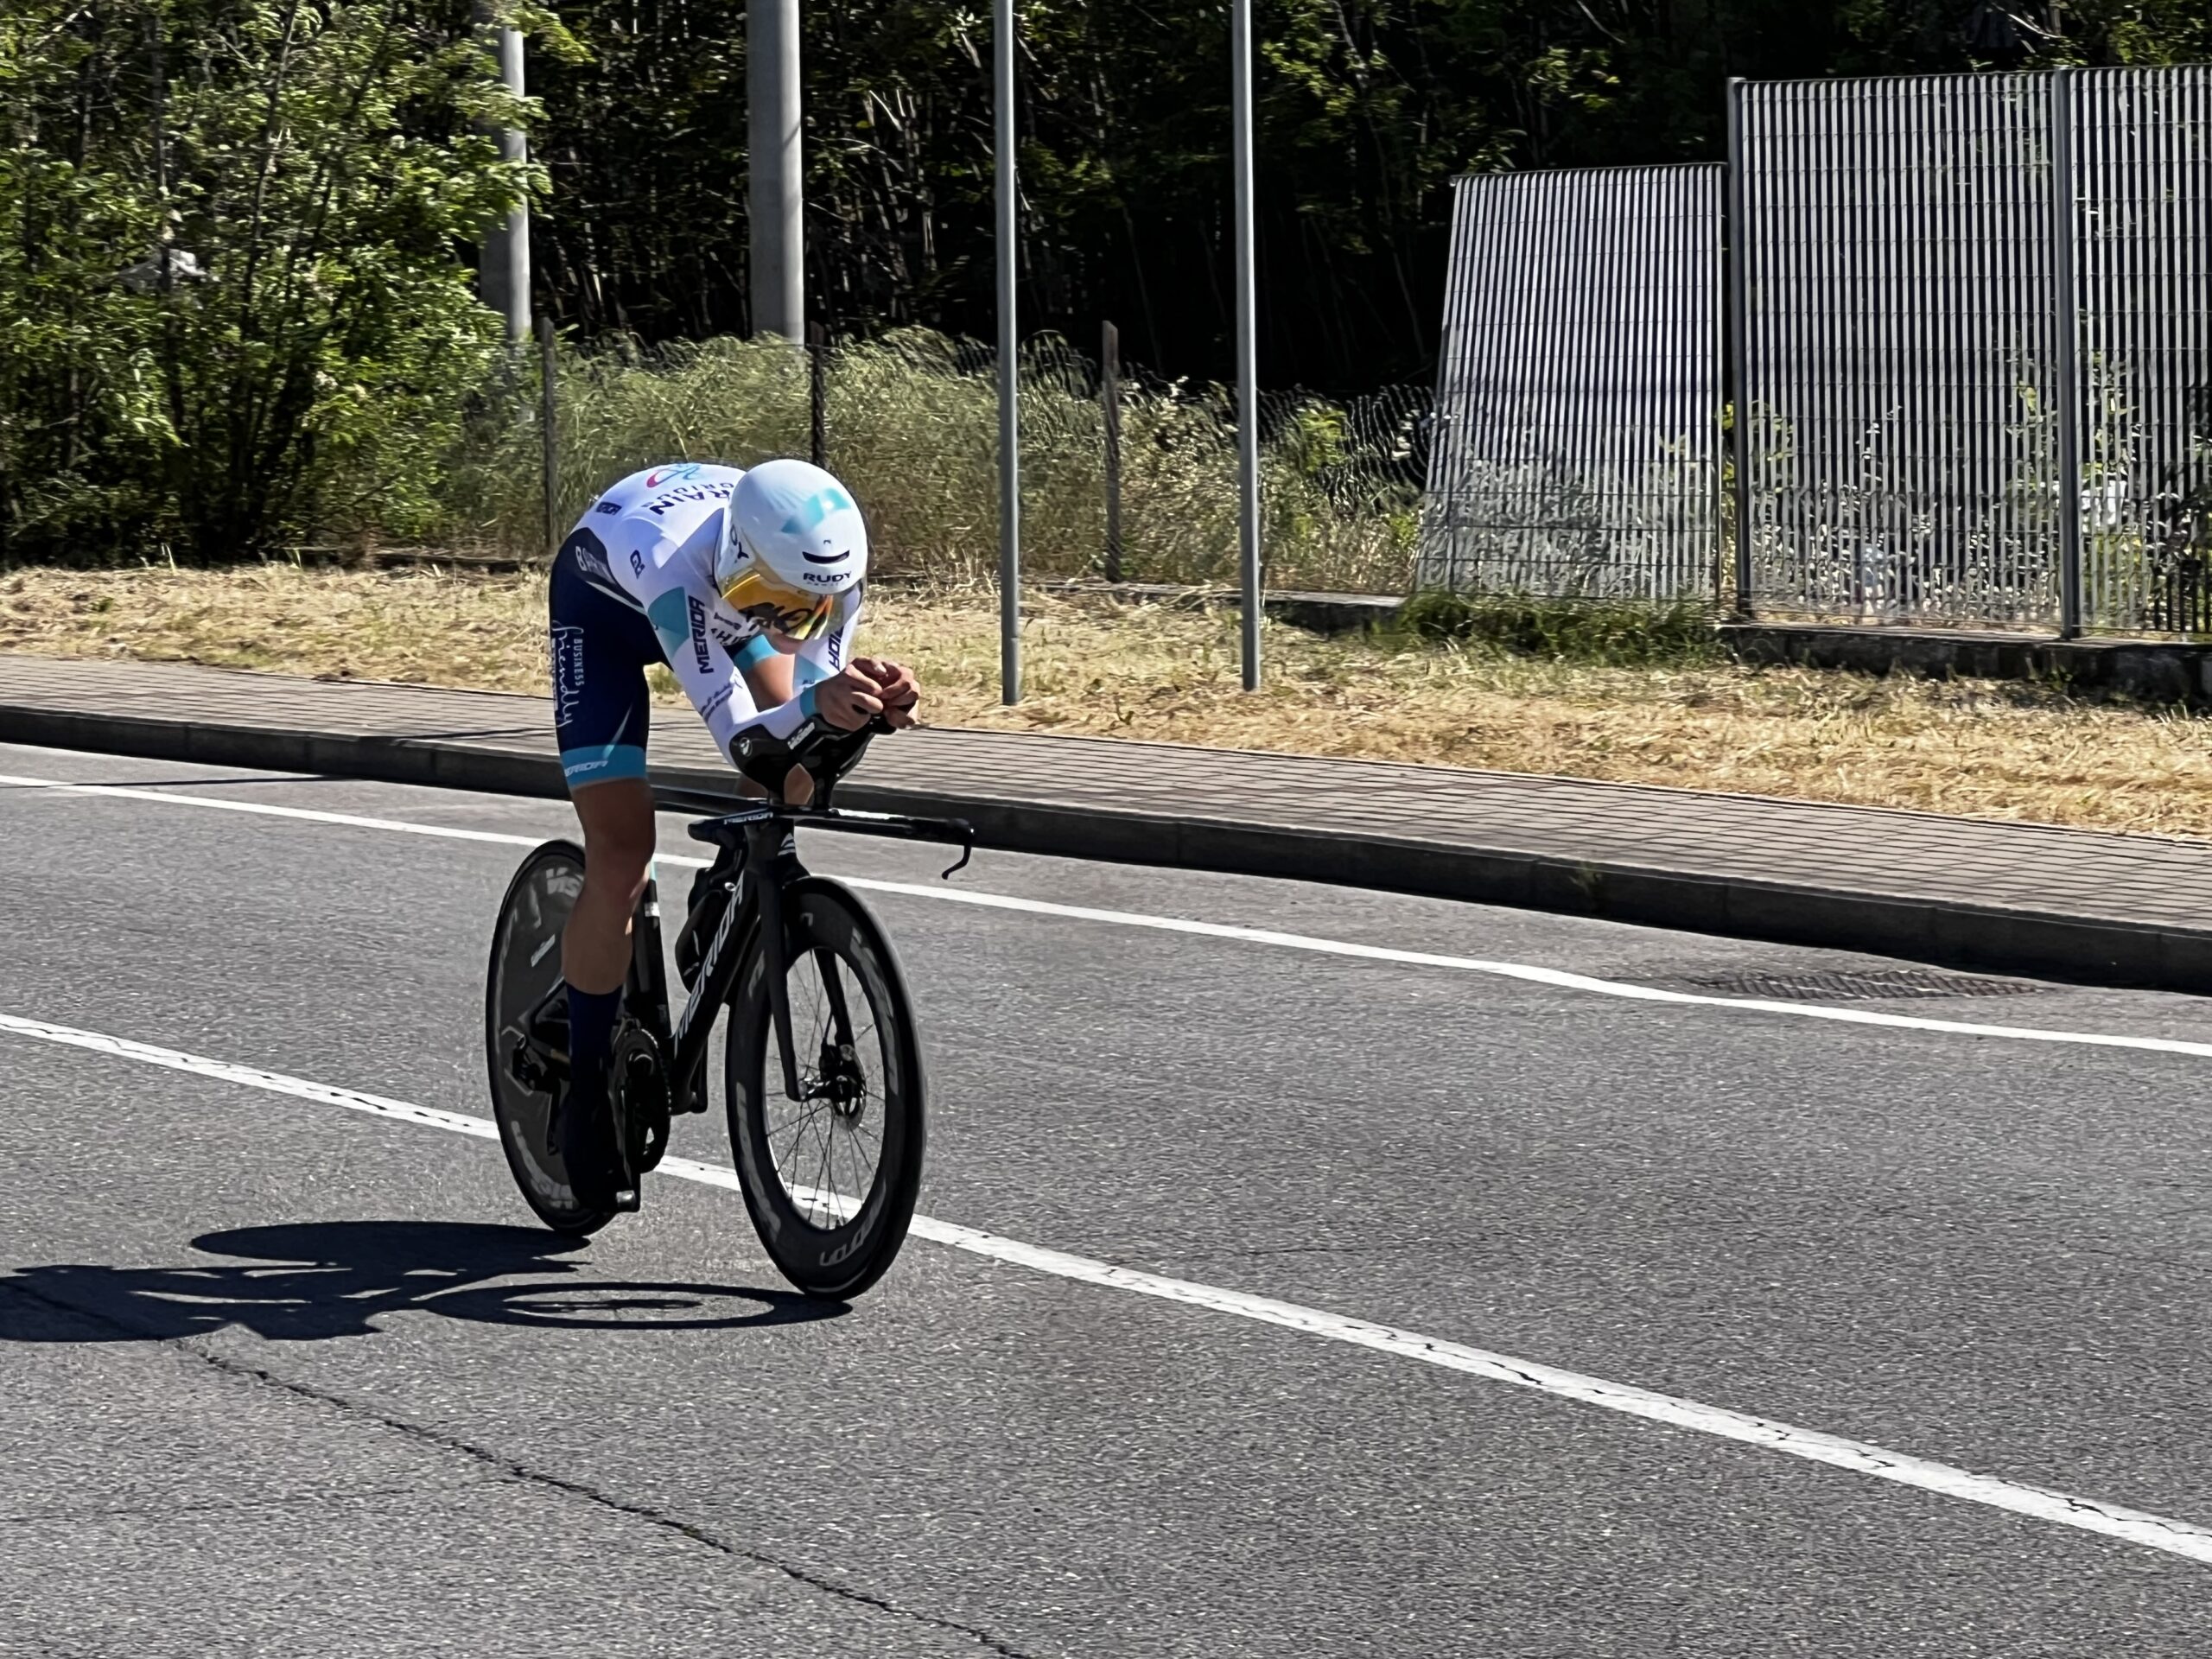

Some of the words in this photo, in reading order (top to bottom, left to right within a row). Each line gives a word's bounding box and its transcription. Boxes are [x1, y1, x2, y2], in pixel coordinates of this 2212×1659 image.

[649, 489, 731, 515] RAIN
[803, 571, 852, 582] RUDY
[573, 638, 585, 686] BUSINESS
[688, 595, 715, 675] MERIDA
[550, 620, 584, 728] friendly
[673, 869, 744, 1060] MERIDA
